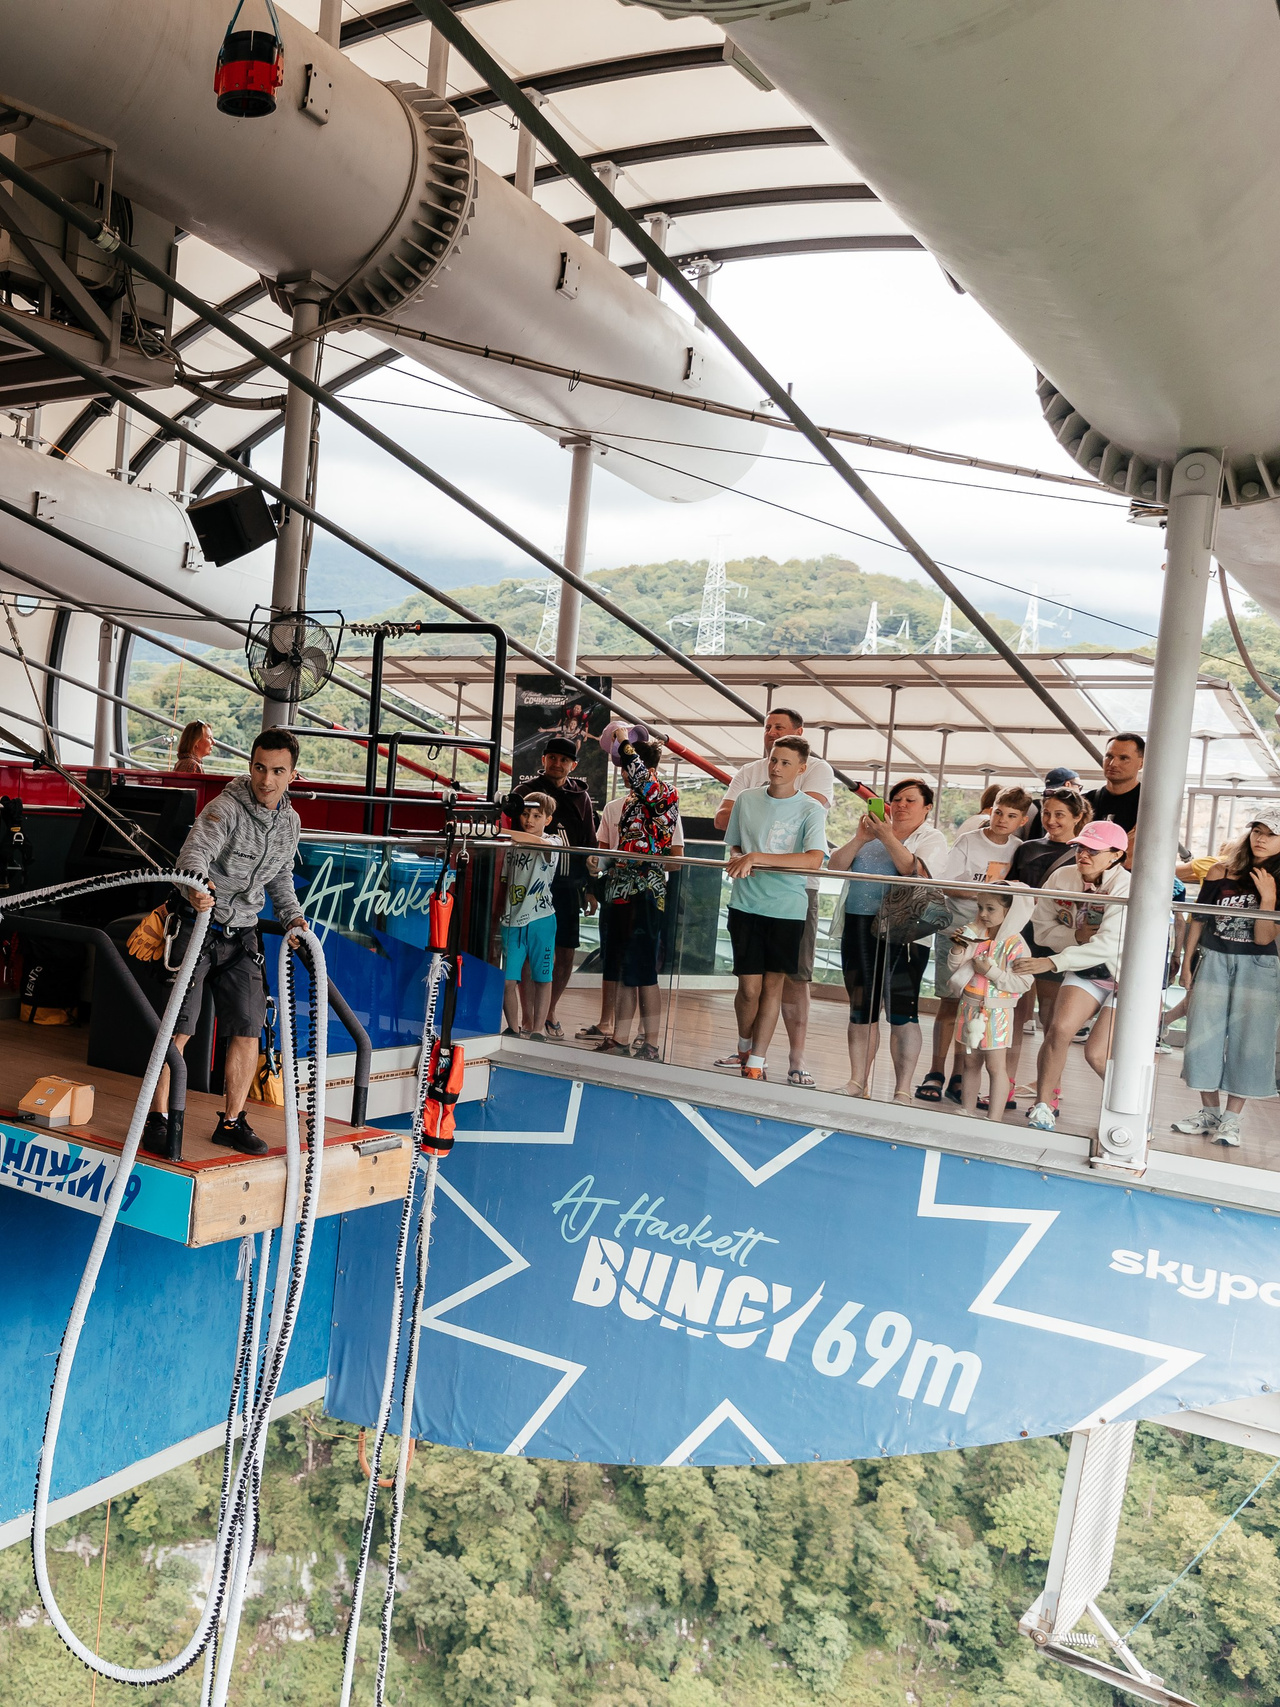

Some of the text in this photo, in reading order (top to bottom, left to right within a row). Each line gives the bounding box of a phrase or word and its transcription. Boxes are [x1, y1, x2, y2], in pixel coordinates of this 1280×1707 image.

[349, 861, 457, 932] Hacke
[24, 966, 43, 997] VENTO
[552, 1174, 780, 1267] AJ Hackett
[572, 1235, 826, 1363] BUNGY
